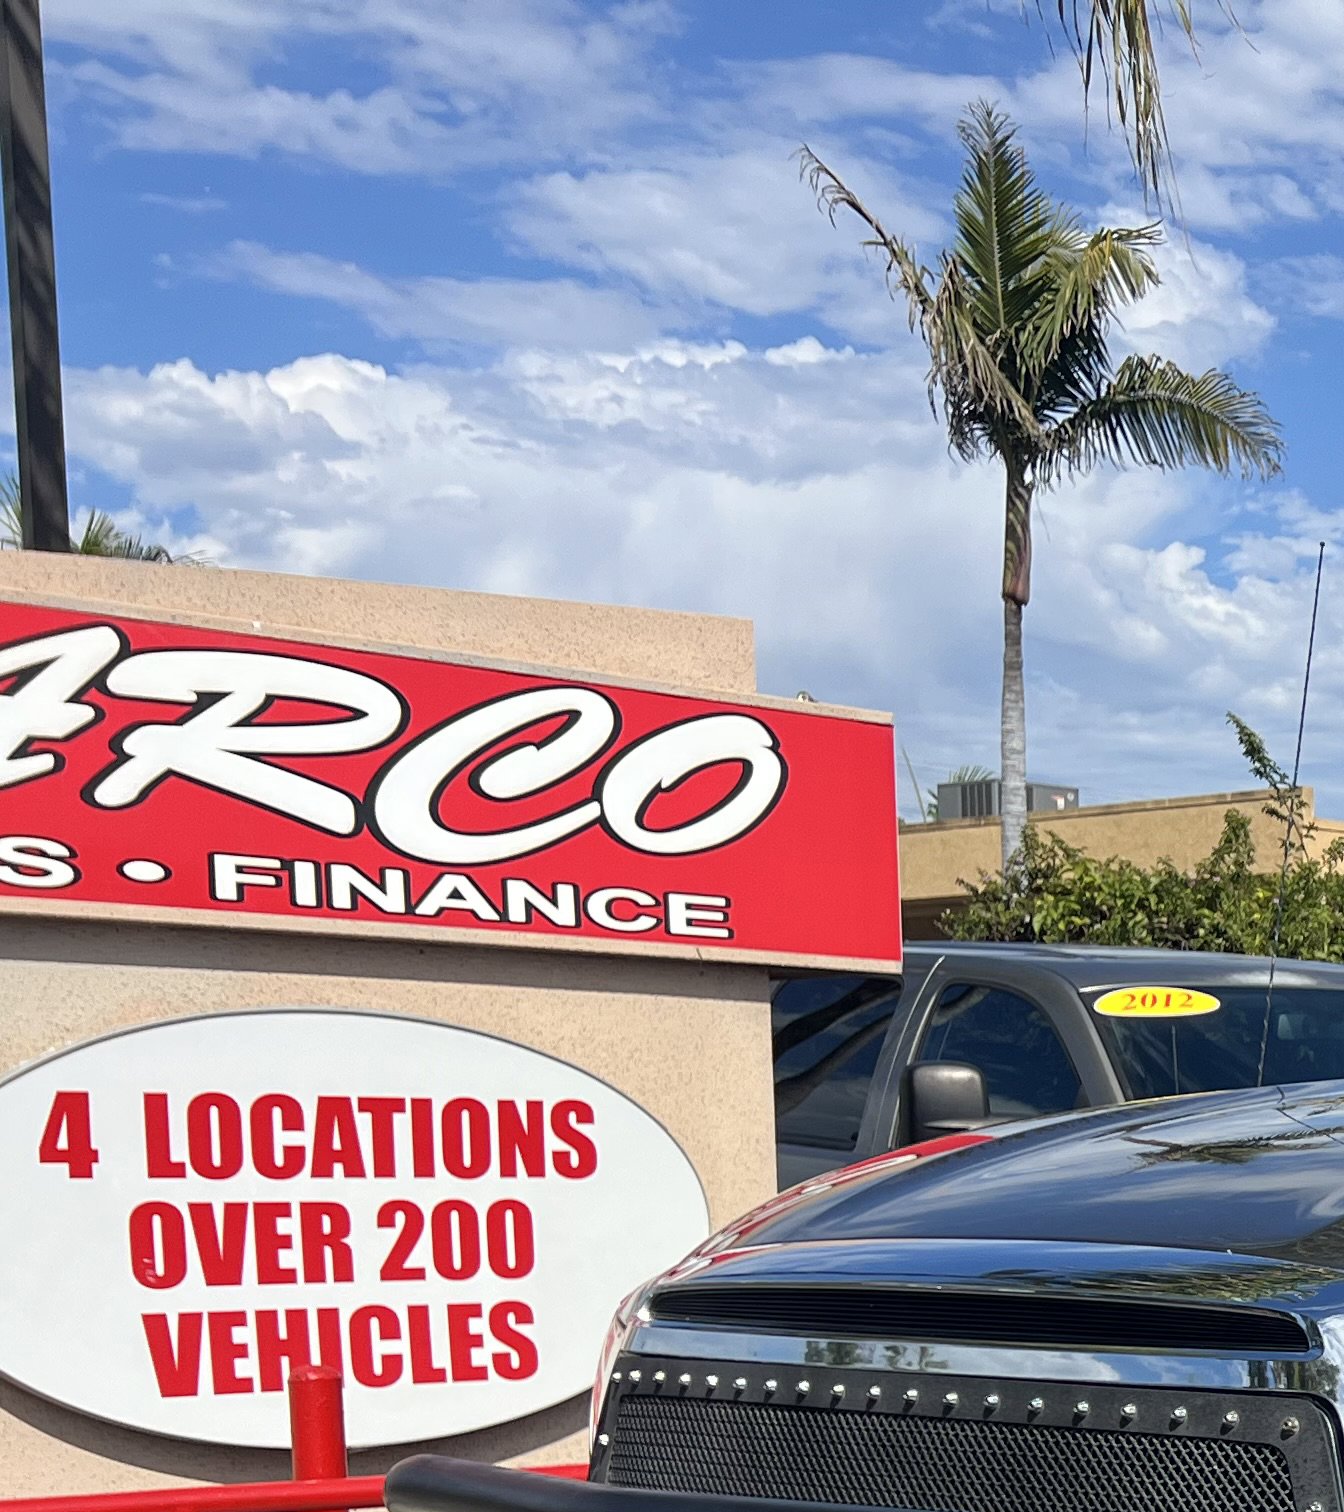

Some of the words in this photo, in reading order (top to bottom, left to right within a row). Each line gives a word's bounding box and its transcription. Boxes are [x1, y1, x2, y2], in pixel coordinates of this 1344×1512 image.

[210, 852, 735, 940] FINANCE
[1122, 993, 1193, 1010] 2012
[38, 1090, 99, 1180] 4
[143, 1091, 599, 1181] LOCATIONS
[128, 1201, 354, 1290] OVER
[376, 1199, 536, 1281] 200
[141, 1300, 539, 1398] VEHICLES
